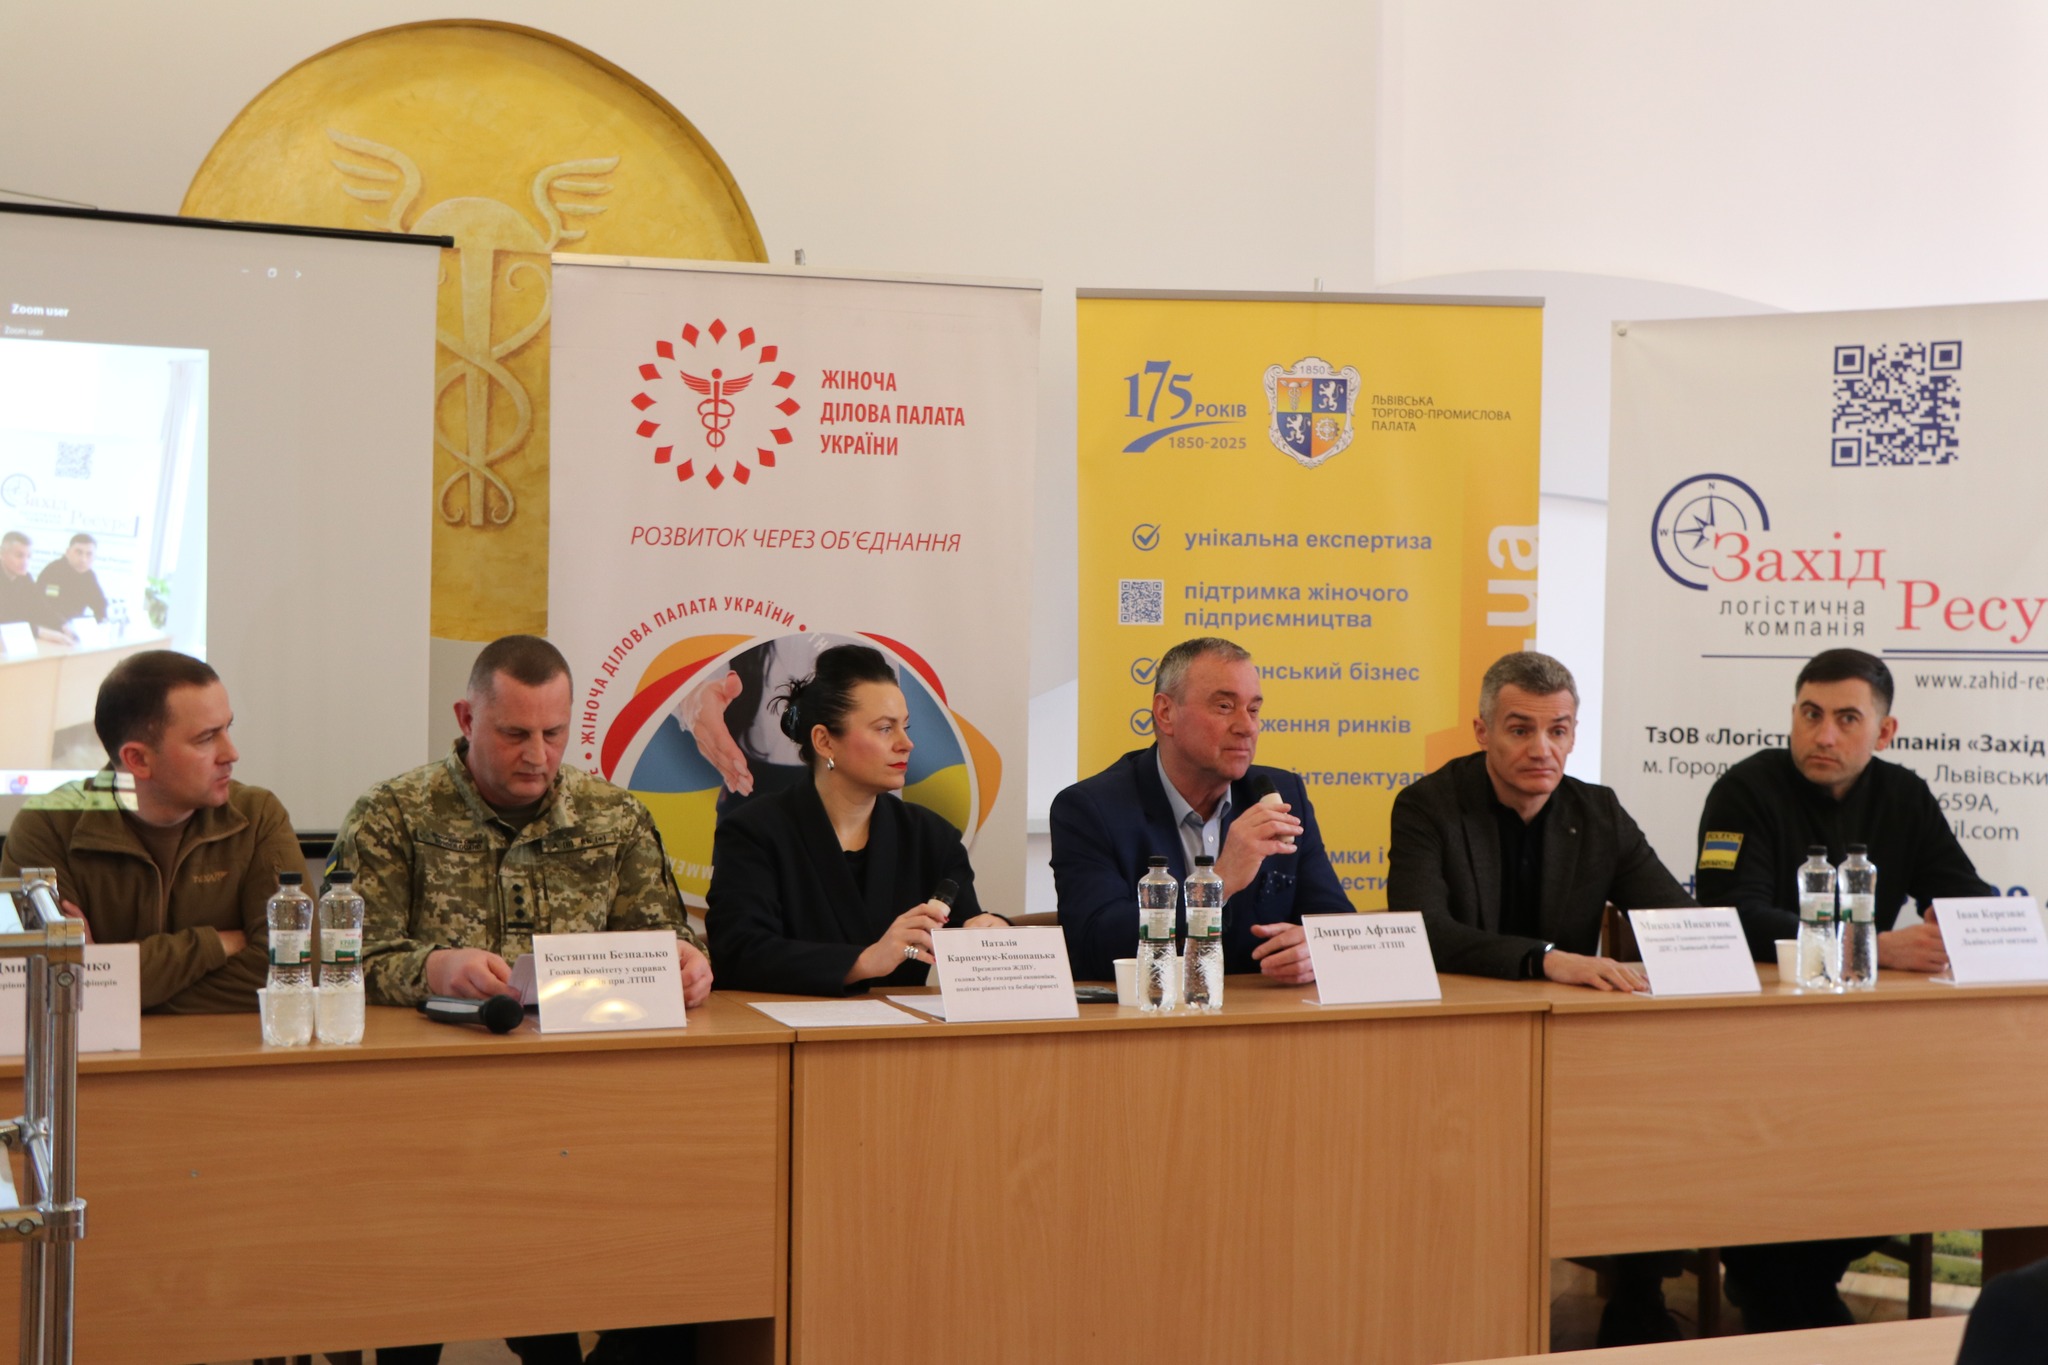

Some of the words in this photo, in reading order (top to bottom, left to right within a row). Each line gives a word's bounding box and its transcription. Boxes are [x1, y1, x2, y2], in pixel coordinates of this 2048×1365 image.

[10, 303, 44, 316] Zoom
[45, 306, 70, 318] user
[1299, 365, 1326, 376] 1850
[821, 369, 897, 392] ЖІНОЧА
[1123, 360, 1194, 423] 175
[1195, 404, 1247, 419] РОКІВ
[1371, 394, 1434, 406] ЛЬВІВСЬКА
[820, 402, 892, 426] ДІЛОВА
[896, 405, 966, 426] ПАЛАТА
[1371, 407, 1512, 422] ТОРГОВО-ПРОМИСЛОВА
[1371, 421, 1417, 433] ПАЛАТА
[820, 433, 899, 456] УКРАЇНИ
[1168, 436, 1247, 450] 1850-2025
[1708, 482, 1716, 490] N
[630, 526, 748, 548] РОЗВИТОК
[752, 529, 816, 549] ЧЕРЕЗ
[1184, 529, 1299, 552] унікальна
[1305, 533, 1433, 553] експертиза
[1659, 529, 1669, 537] W
[1711, 531, 1887, 590] Захід
[1184, 581, 1301, 603] підтримка
[1307, 582, 1409, 604] жіночого
[1719, 596, 1866, 616] логістична
[1896, 579, 2048, 645] Ресу
[1184, 608, 1373, 630] підприємництва
[1744, 617, 1866, 637] компанія
[581, 677, 609, 745] ЖІНОЧА
[601, 622, 653, 677] ДІЛОВА
[653, 597, 718, 628] ПАЛАТА
[724, 596, 796, 628] УКРАЇНИ
[1350, 662, 1420, 681] бізнес
[1337, 715, 1412, 737] ринків
[1645, 726, 1700, 744] ТзОВ
[1643, 760, 1663, 774] м.
[1668, 756, 1731, 779] Город
[1313, 926, 1362, 939] Дмитро
[1365, 924, 1417, 938] Афтанас
[981, 939, 1018, 948] Наталія
[1333, 943, 1377, 952] Президент
[1379, 941, 1406, 950] ЛТПП
[544, 952, 607, 963] Костянтин
[610, 949, 669, 961] Безпалько
[947, 952, 1056, 964] Карпенчук-Конопацька
[549, 968, 581, 976] Голова
[583, 965, 623, 975] Комітету
[632, 965, 668, 975] справах
[627, 975, 656, 985] ЛТПП
